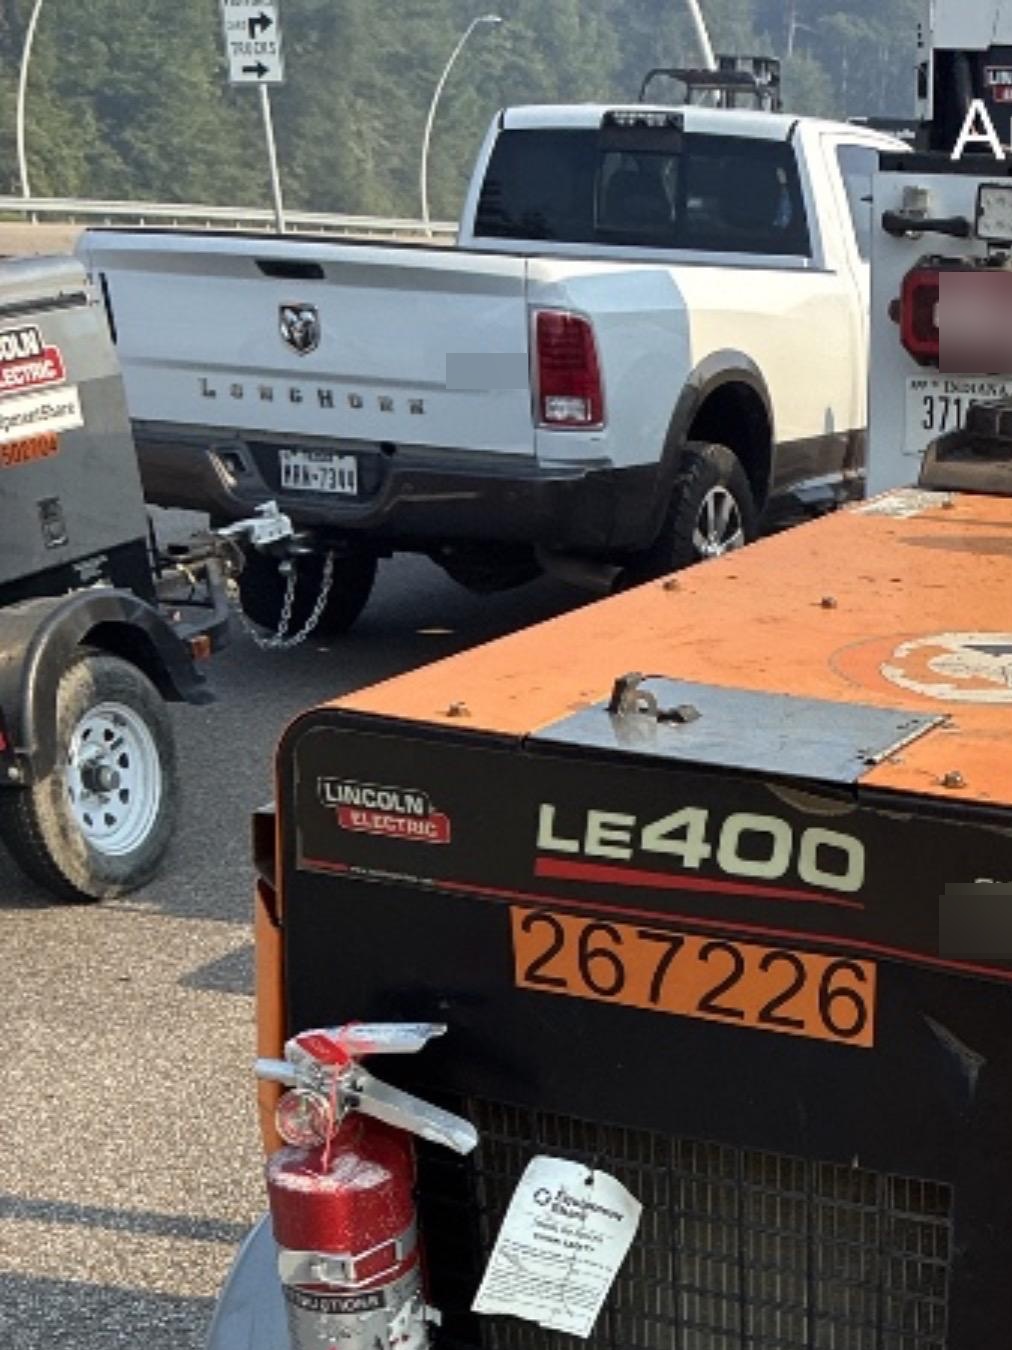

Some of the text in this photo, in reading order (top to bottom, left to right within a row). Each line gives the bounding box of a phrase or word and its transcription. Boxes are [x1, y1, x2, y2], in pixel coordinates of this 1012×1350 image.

[198, 377, 426, 416] LONGHORN
[944, 381, 1008, 397] INDIANA
[923, 396, 976, 430] 371
[325, 782, 424, 815] LINCOLN
[351, 811, 438, 838] ELECTRIC
[536, 803, 865, 892] LE400
[521, 911, 867, 1037] 267226
